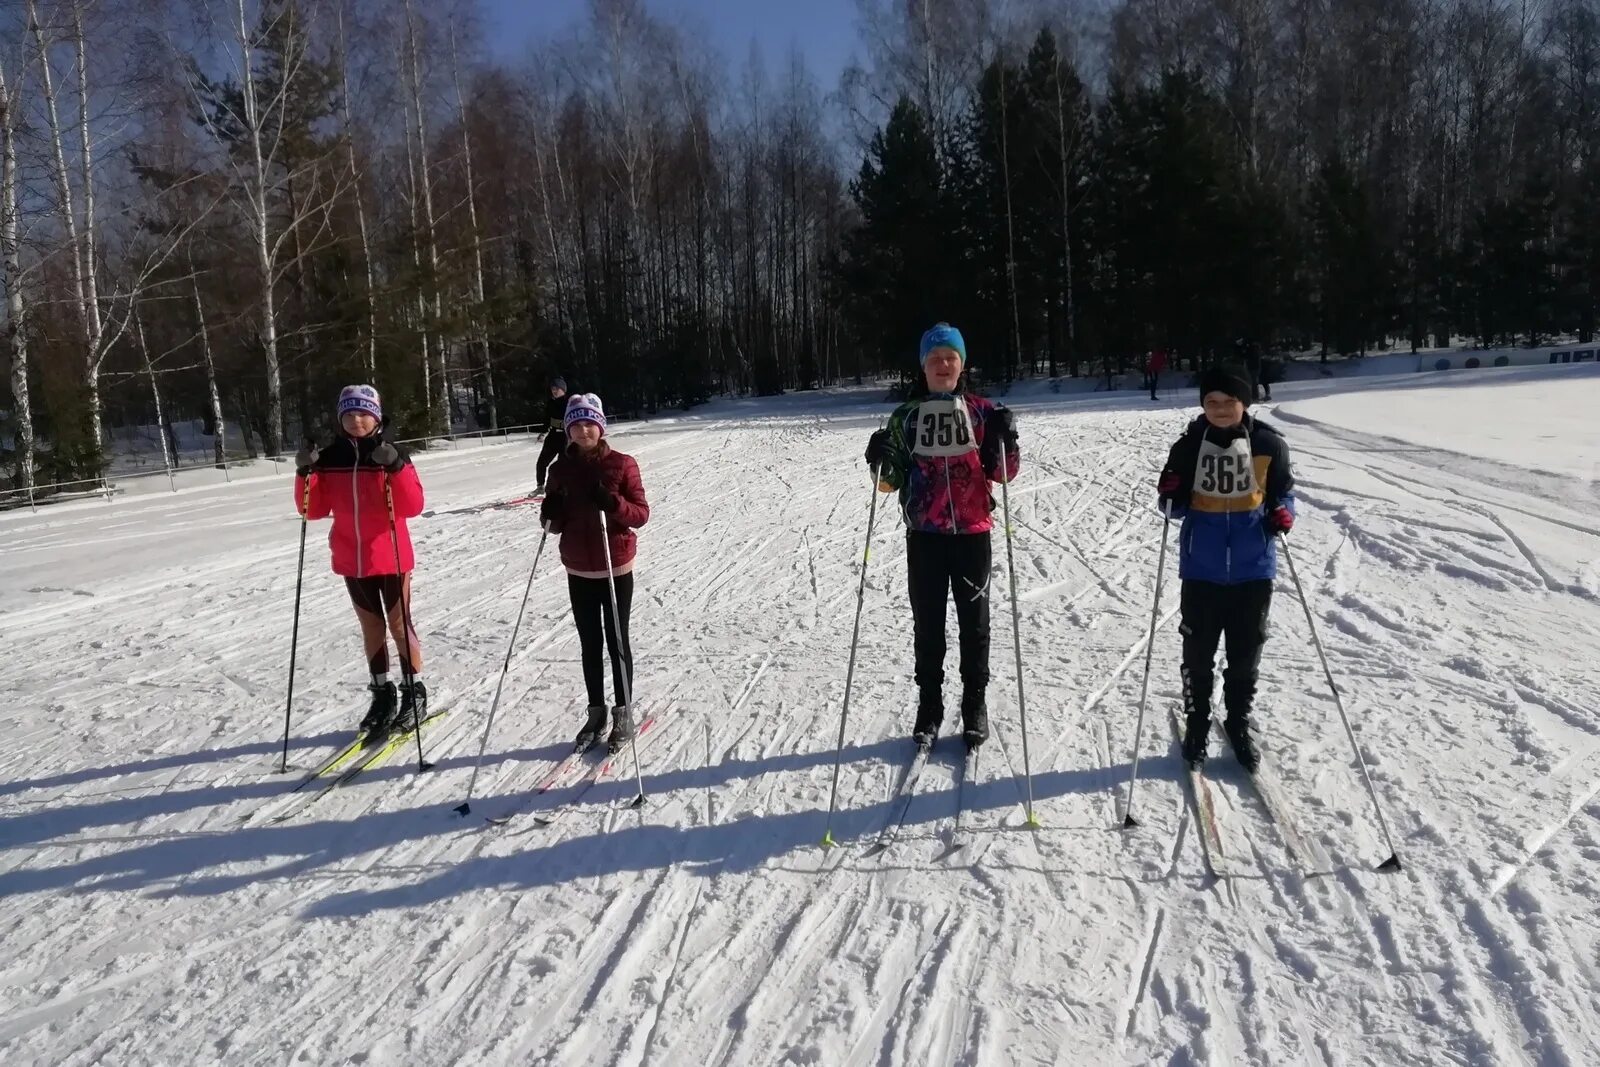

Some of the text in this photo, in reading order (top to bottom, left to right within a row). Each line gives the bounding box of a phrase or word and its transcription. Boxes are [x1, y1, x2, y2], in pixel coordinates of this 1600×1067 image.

[1549, 349, 1600, 364] ПР
[921, 409, 969, 447] 358
[1201, 454, 1250, 494] 365
